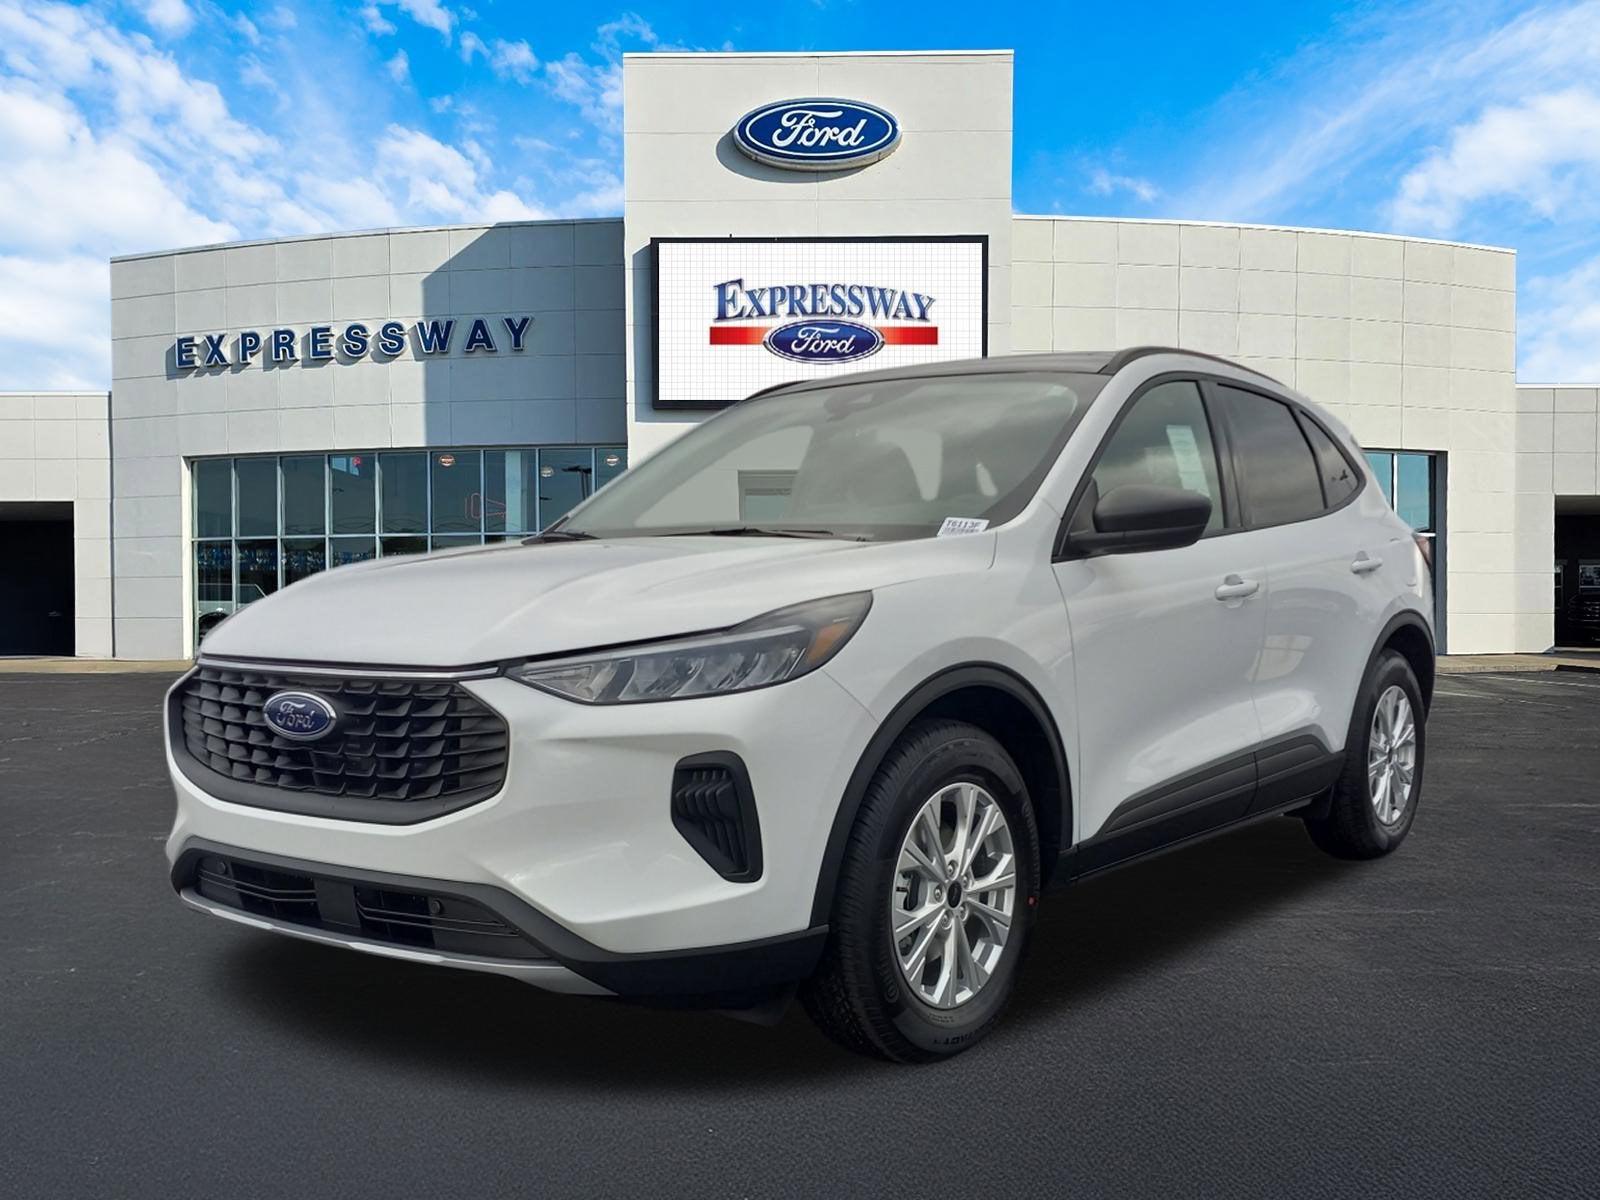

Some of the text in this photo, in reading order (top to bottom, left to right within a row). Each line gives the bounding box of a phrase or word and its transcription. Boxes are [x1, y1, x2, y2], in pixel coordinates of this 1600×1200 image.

[771, 110, 867, 147] Ford
[713, 278, 937, 323] EXPRESSWAY
[174, 316, 534, 369] EXPRESSWAY
[791, 326, 856, 354] Ford
[276, 701, 316, 729] Ford
